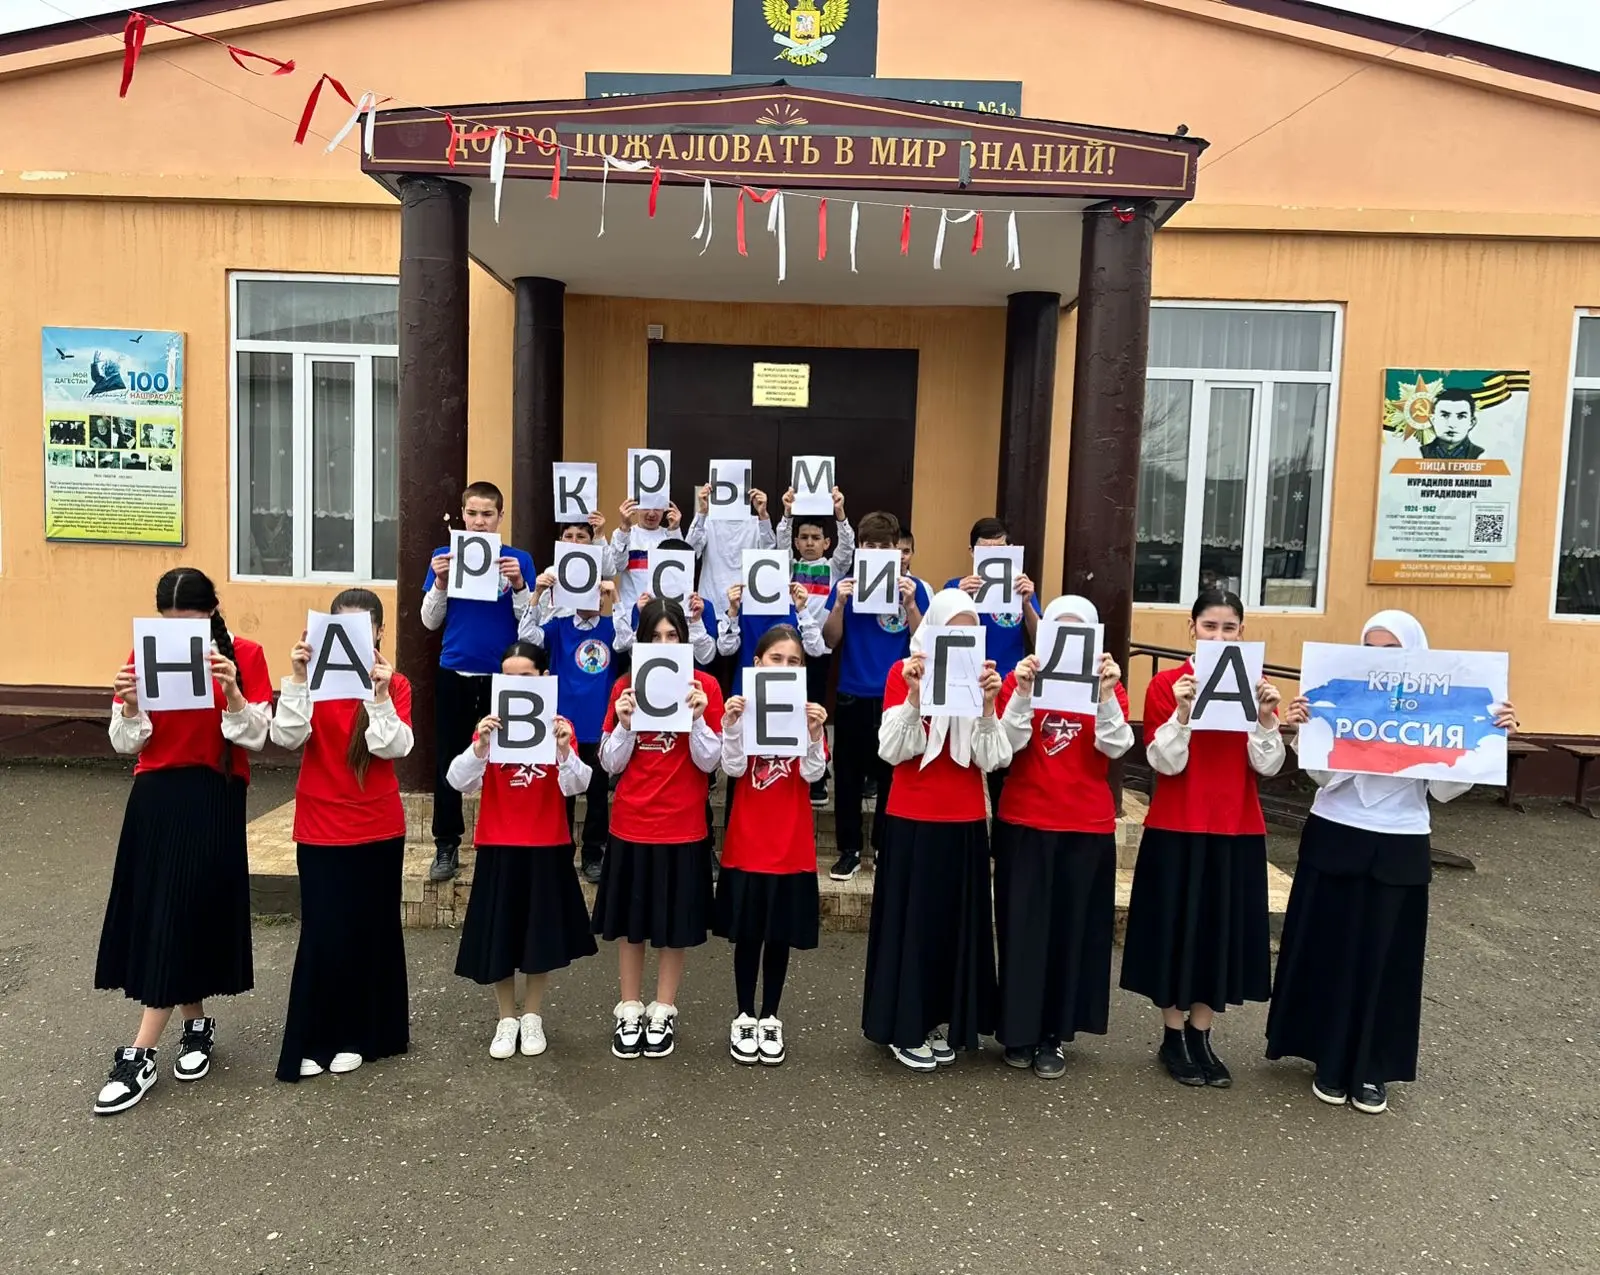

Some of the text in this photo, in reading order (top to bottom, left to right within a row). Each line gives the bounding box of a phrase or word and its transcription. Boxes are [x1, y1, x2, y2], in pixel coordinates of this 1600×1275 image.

[573, 133, 821, 165] ПОЖАЛОВАТЬ
[834, 136, 855, 166] В
[869, 136, 947, 169] МИР
[960, 139, 1117, 176] ЗНАНИЙ!
[127, 371, 169, 392] 100
[1421, 490, 1478, 499] НУРАДИЛОВИЧ
[143, 635, 207, 699] Н
[309, 623, 373, 691] А
[634, 657, 680, 718] С
[932, 635, 977, 706] Г
[1033, 626, 1100, 704] Д
[1190, 645, 1259, 722] А
[1367, 670, 1452, 697] КРЫМ
[497, 689, 547, 750] В
[755, 671, 799, 747] Е
[1335, 717, 1466, 750] РОССИЯ
[1388, 697, 1419, 712] ЭТО
